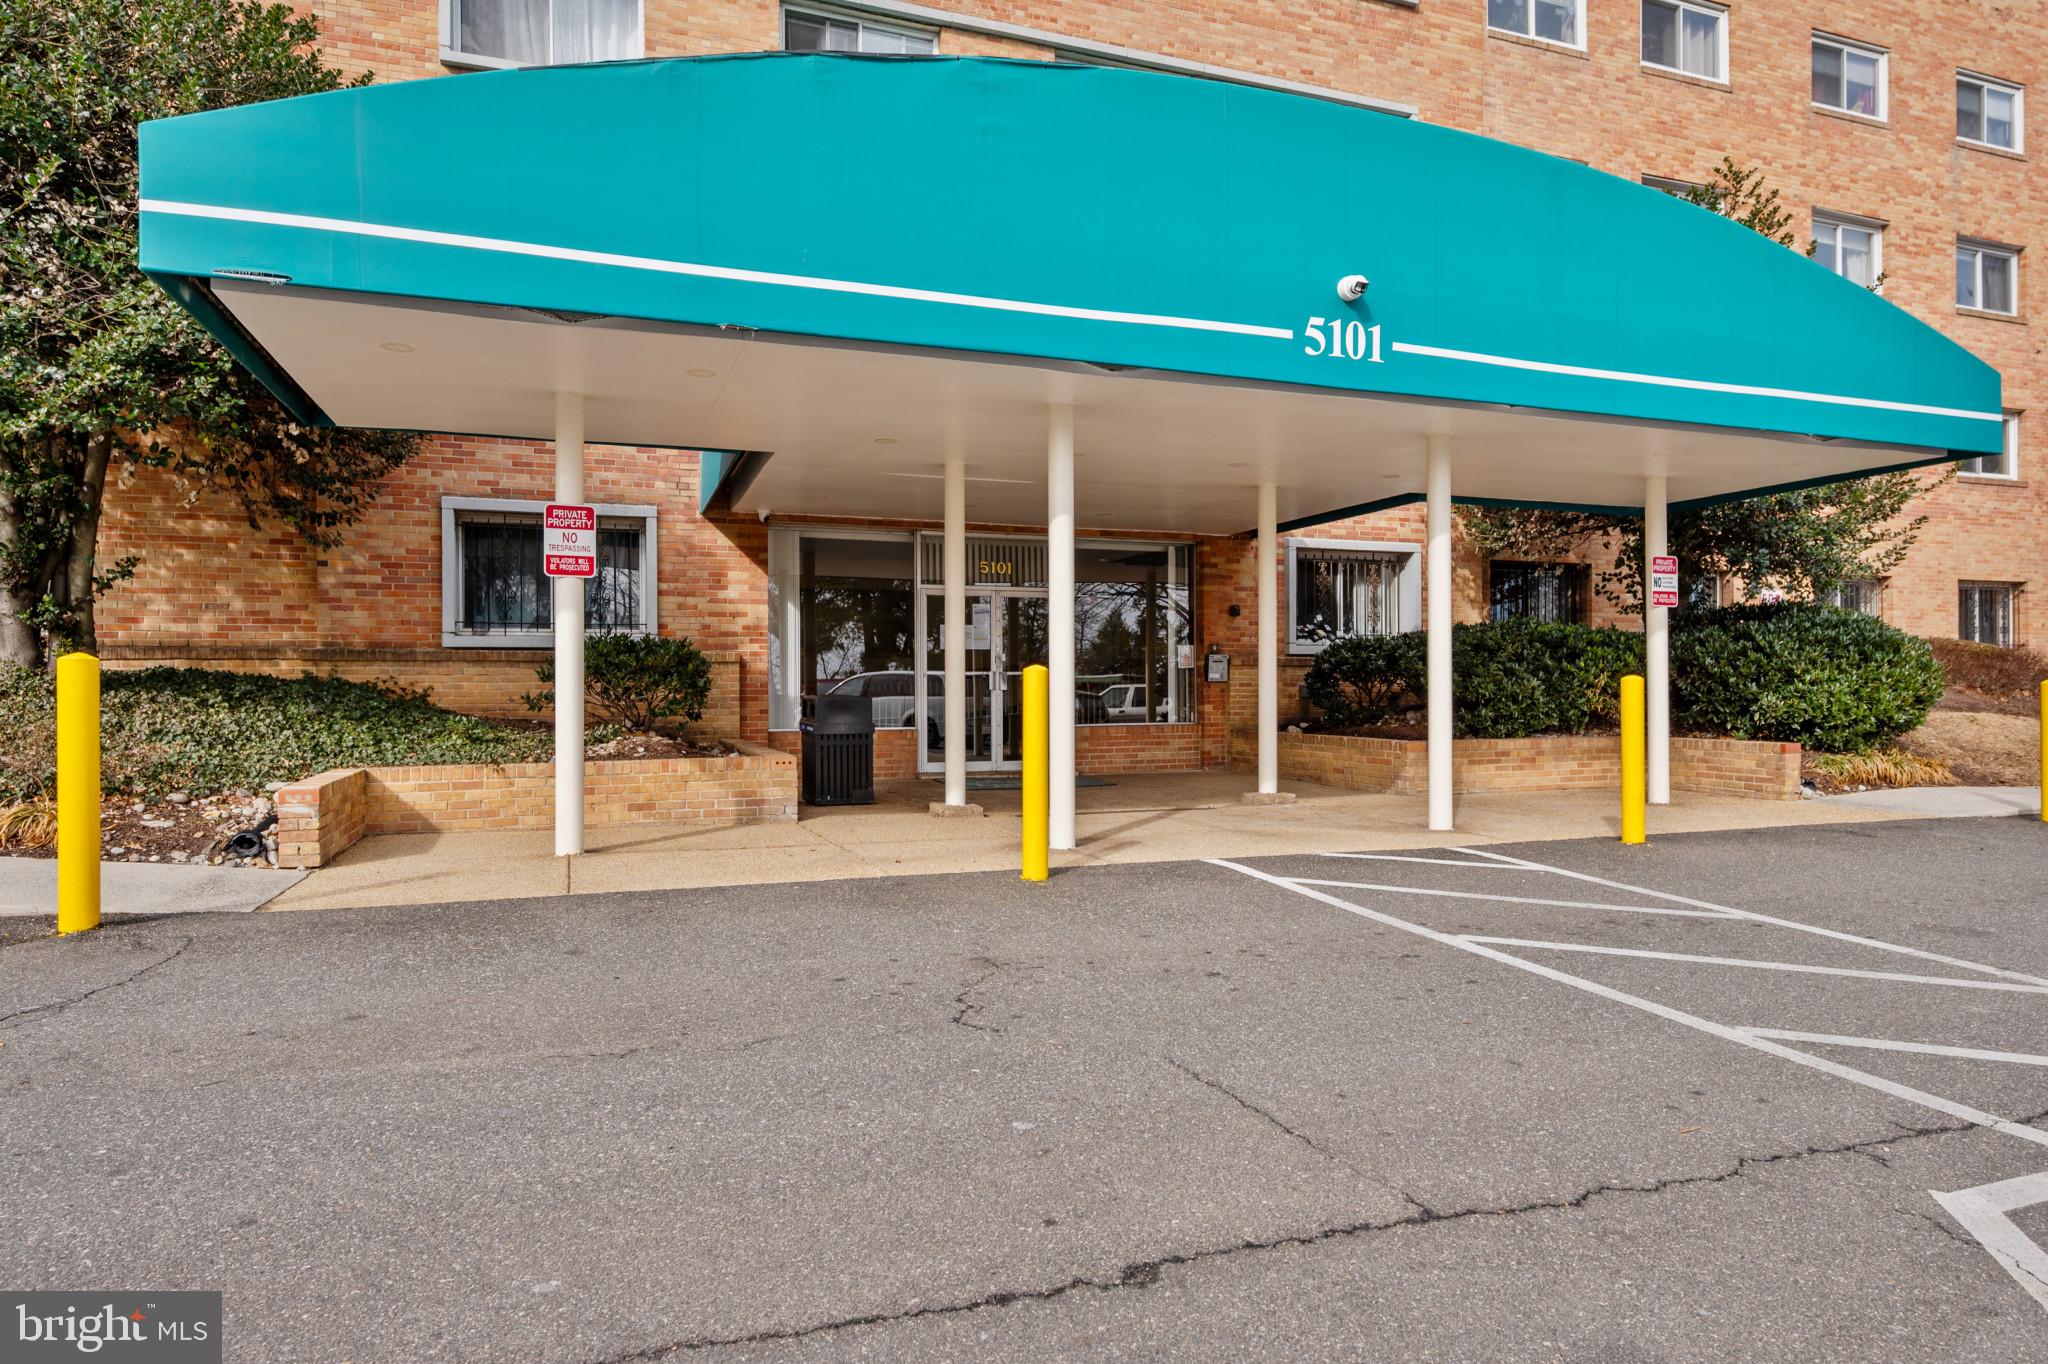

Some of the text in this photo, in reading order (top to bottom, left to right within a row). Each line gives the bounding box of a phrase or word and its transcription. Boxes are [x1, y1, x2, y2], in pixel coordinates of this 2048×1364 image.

[1304, 316, 1384, 363] 5101
[552, 509, 587, 520] PRIVATE
[548, 517, 592, 528] PROPERTY
[562, 532, 577, 543] NO
[548, 544, 591, 553] TRESPASSING
[550, 557, 576, 565] VIOLATORS
[980, 561, 1012, 575] 5101
[1653, 565, 1676, 573] PROPERTY
[1653, 576, 1661, 588] NO
